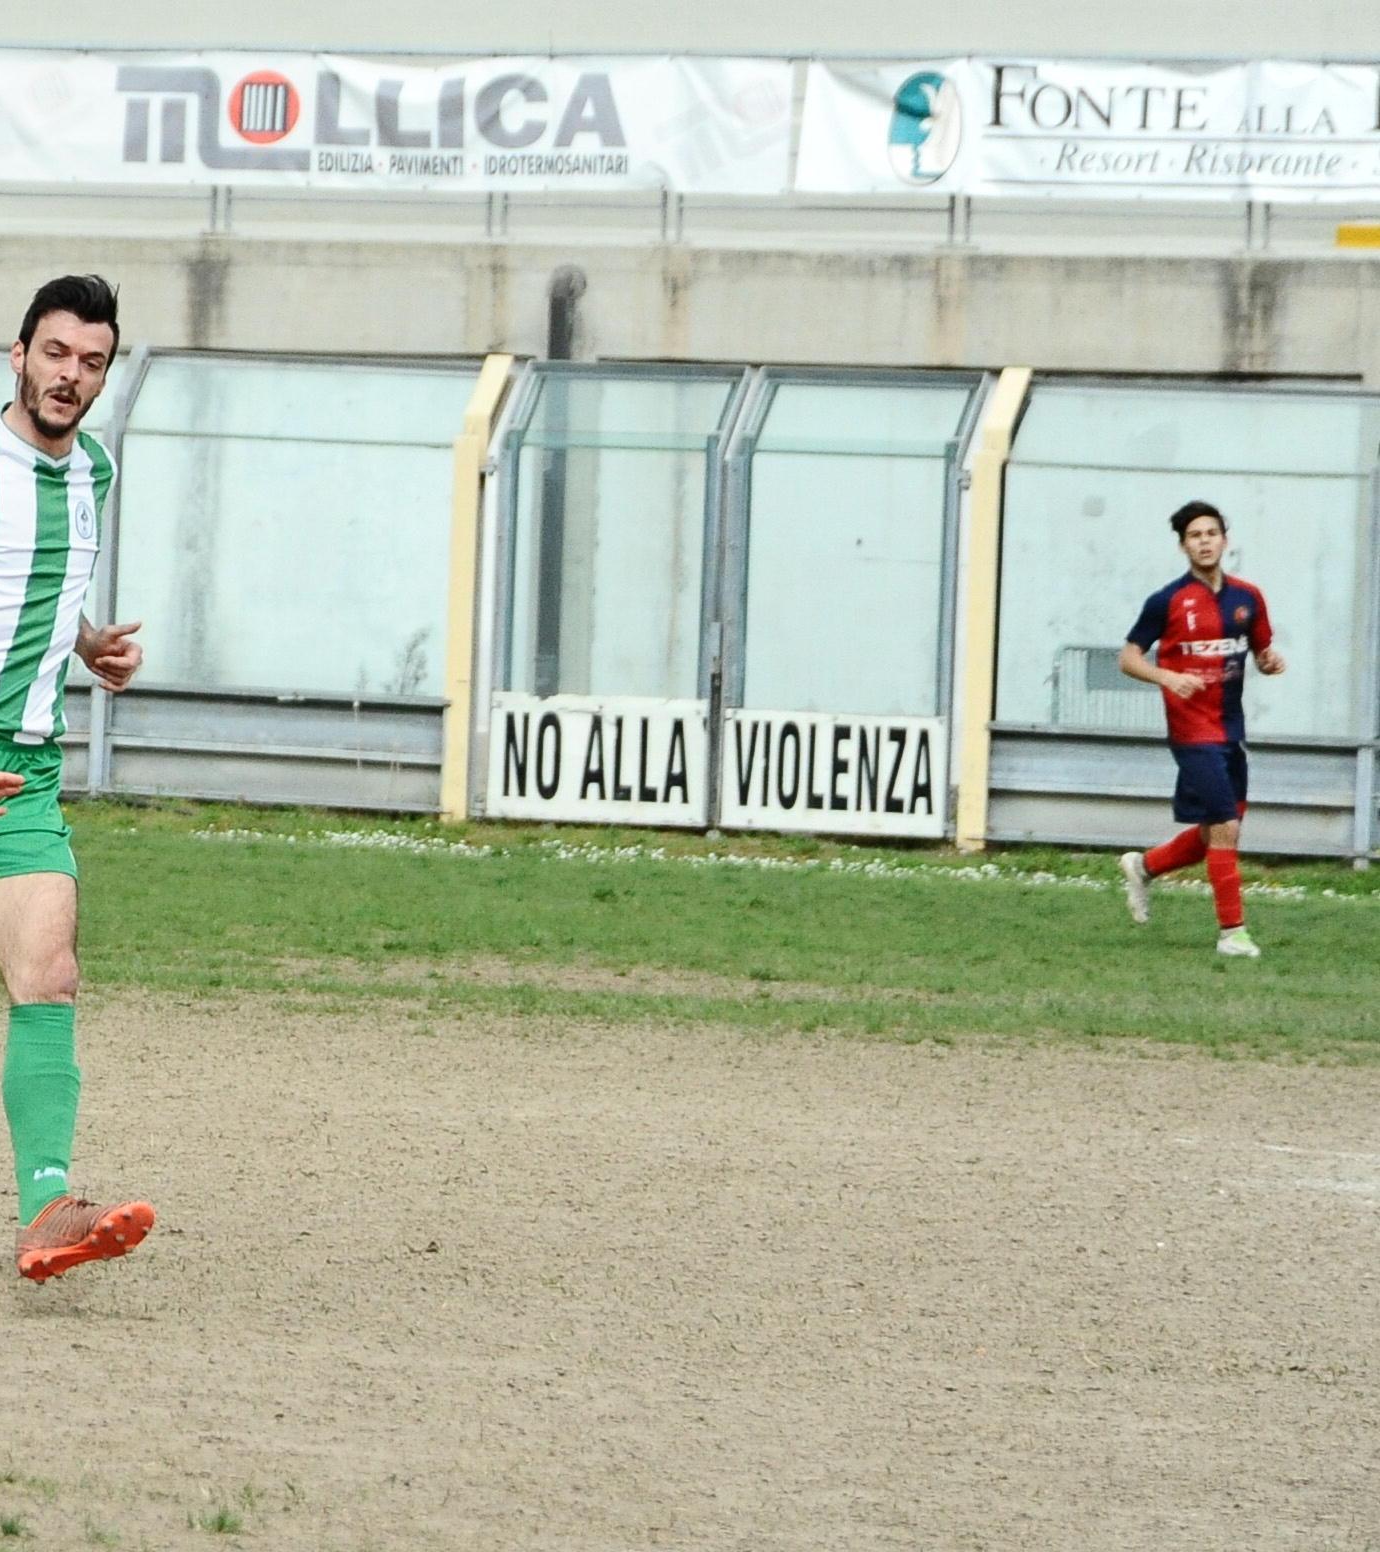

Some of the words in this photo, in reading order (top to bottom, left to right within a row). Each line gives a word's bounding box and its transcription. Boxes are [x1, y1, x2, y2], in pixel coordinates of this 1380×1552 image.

[987, 64, 1208, 132] FONTE
[1235, 104, 1337, 134] ALLA
[318, 151, 374, 174] EDILIZIA
[389, 153, 463, 176] PAVIMENTI
[484, 153, 629, 176] IDROTERMOSANITARI
[1054, 141, 1161, 174] Resort
[502, 711, 562, 800] NO
[580, 714, 690, 804] ALLA
[735, 719, 934, 815] VIOLENZA
